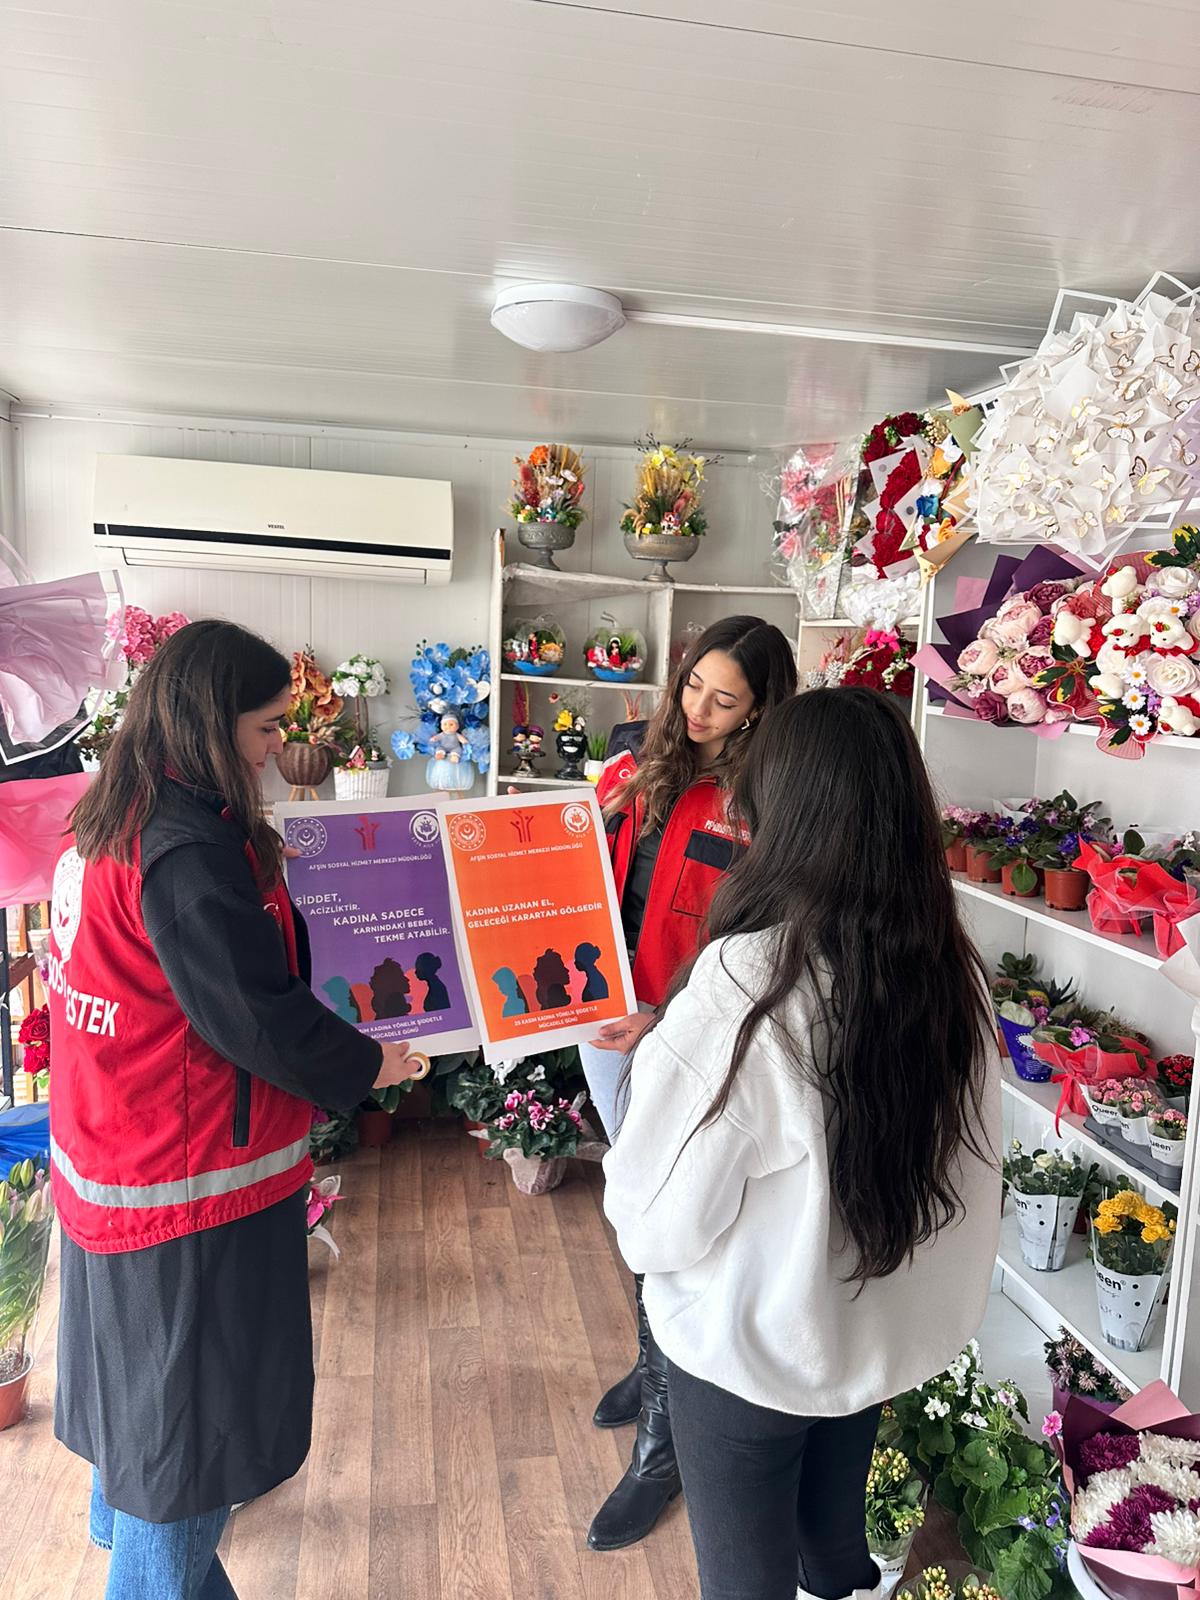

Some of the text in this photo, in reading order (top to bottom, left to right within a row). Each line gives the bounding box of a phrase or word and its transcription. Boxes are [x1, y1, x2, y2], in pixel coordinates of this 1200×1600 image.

[328, 861, 350, 869] SOSYAL
[310, 903, 361, 916] ACİZLİKTİR.
[465, 898, 554, 918] KADINA UZANAN EL,
[468, 902, 602, 929] GELECEĞİ KARARTAN GÖLGEDİR
[333, 908, 425, 926] KADINA SADECE
[353, 918, 434, 935] KARNINDAKİ BEBEK
[374, 927, 450, 944] TEKME ATABİLİR.
[370, 1024, 392, 1032] KADINA
[1150, 1140, 1172, 1152] ueen
